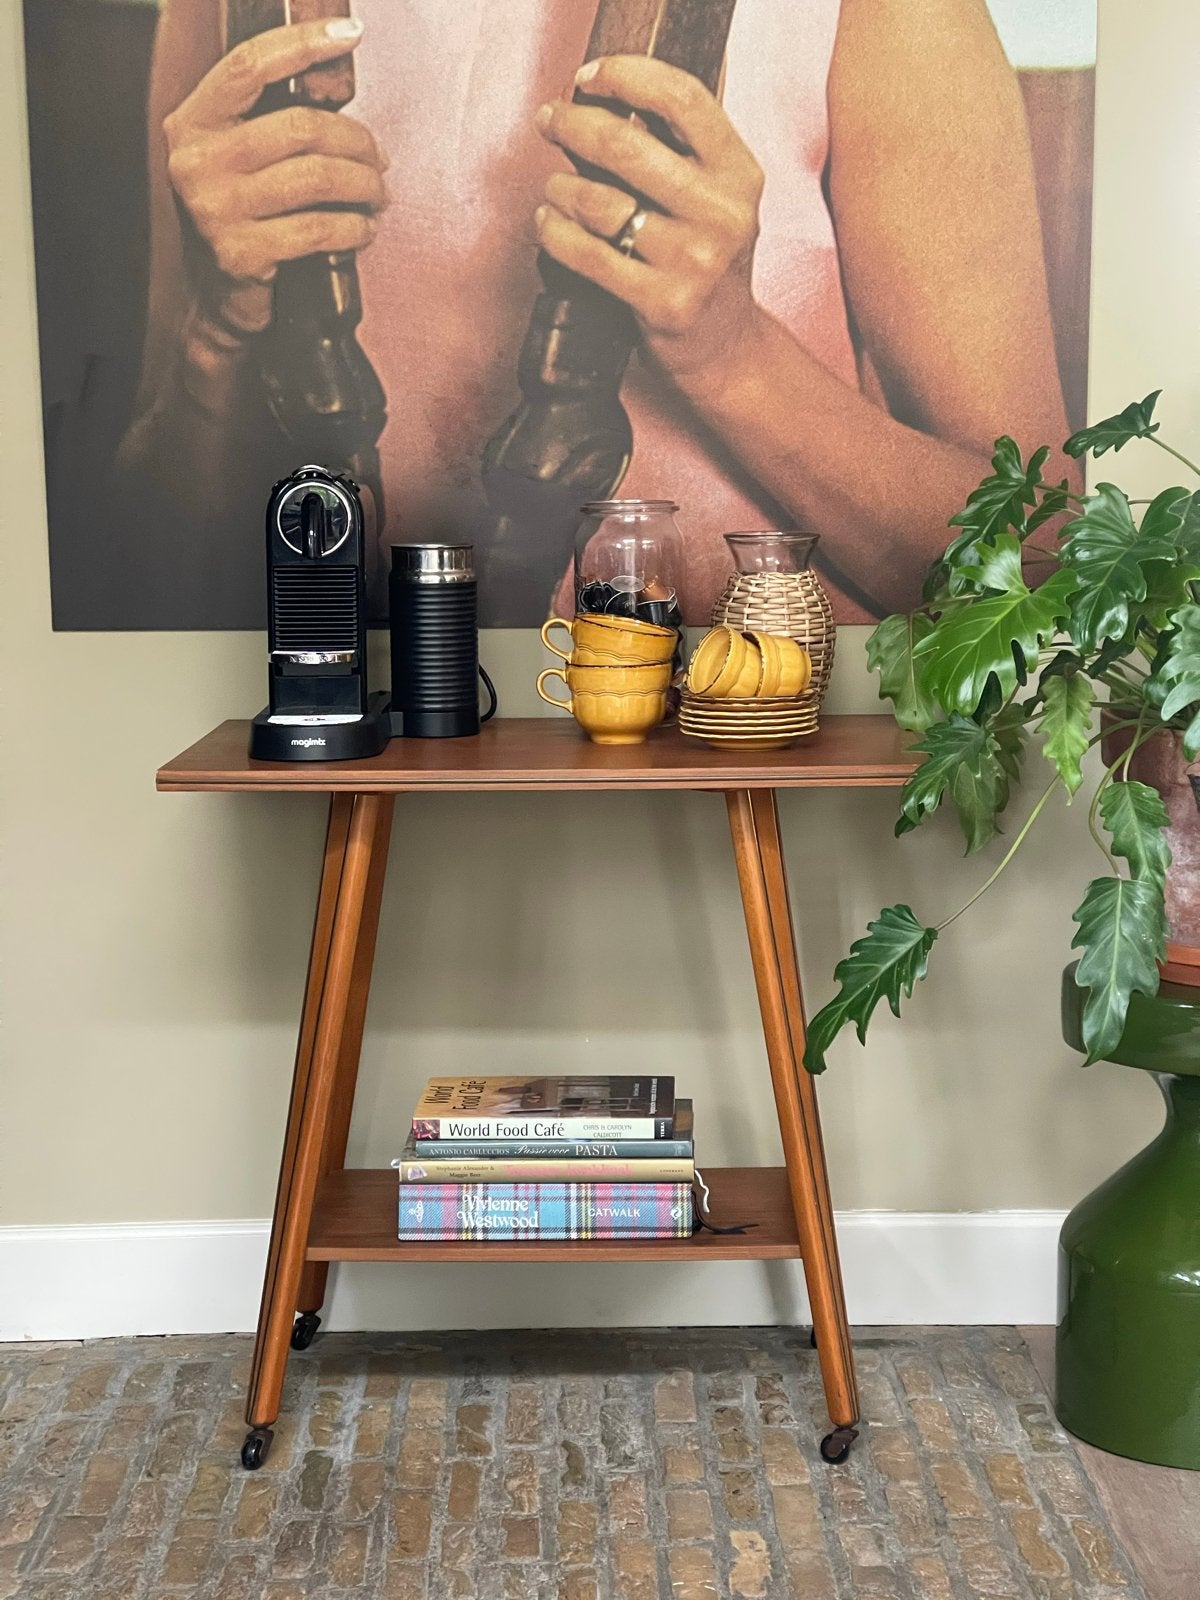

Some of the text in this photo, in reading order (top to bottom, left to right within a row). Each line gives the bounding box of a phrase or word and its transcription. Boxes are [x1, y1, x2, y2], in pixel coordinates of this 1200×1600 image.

[423, 1085, 455, 1104] World
[452, 1080, 487, 1110] Food Café
[449, 1122, 565, 1137] World Food Café
[429, 1147, 462, 1156] ANTONIO
[575, 1144, 618, 1156] PASTA
[462, 1194, 529, 1212] Vivienne
[456, 1211, 539, 1229] Westwood
[588, 1208, 641, 1217] CATWALK
